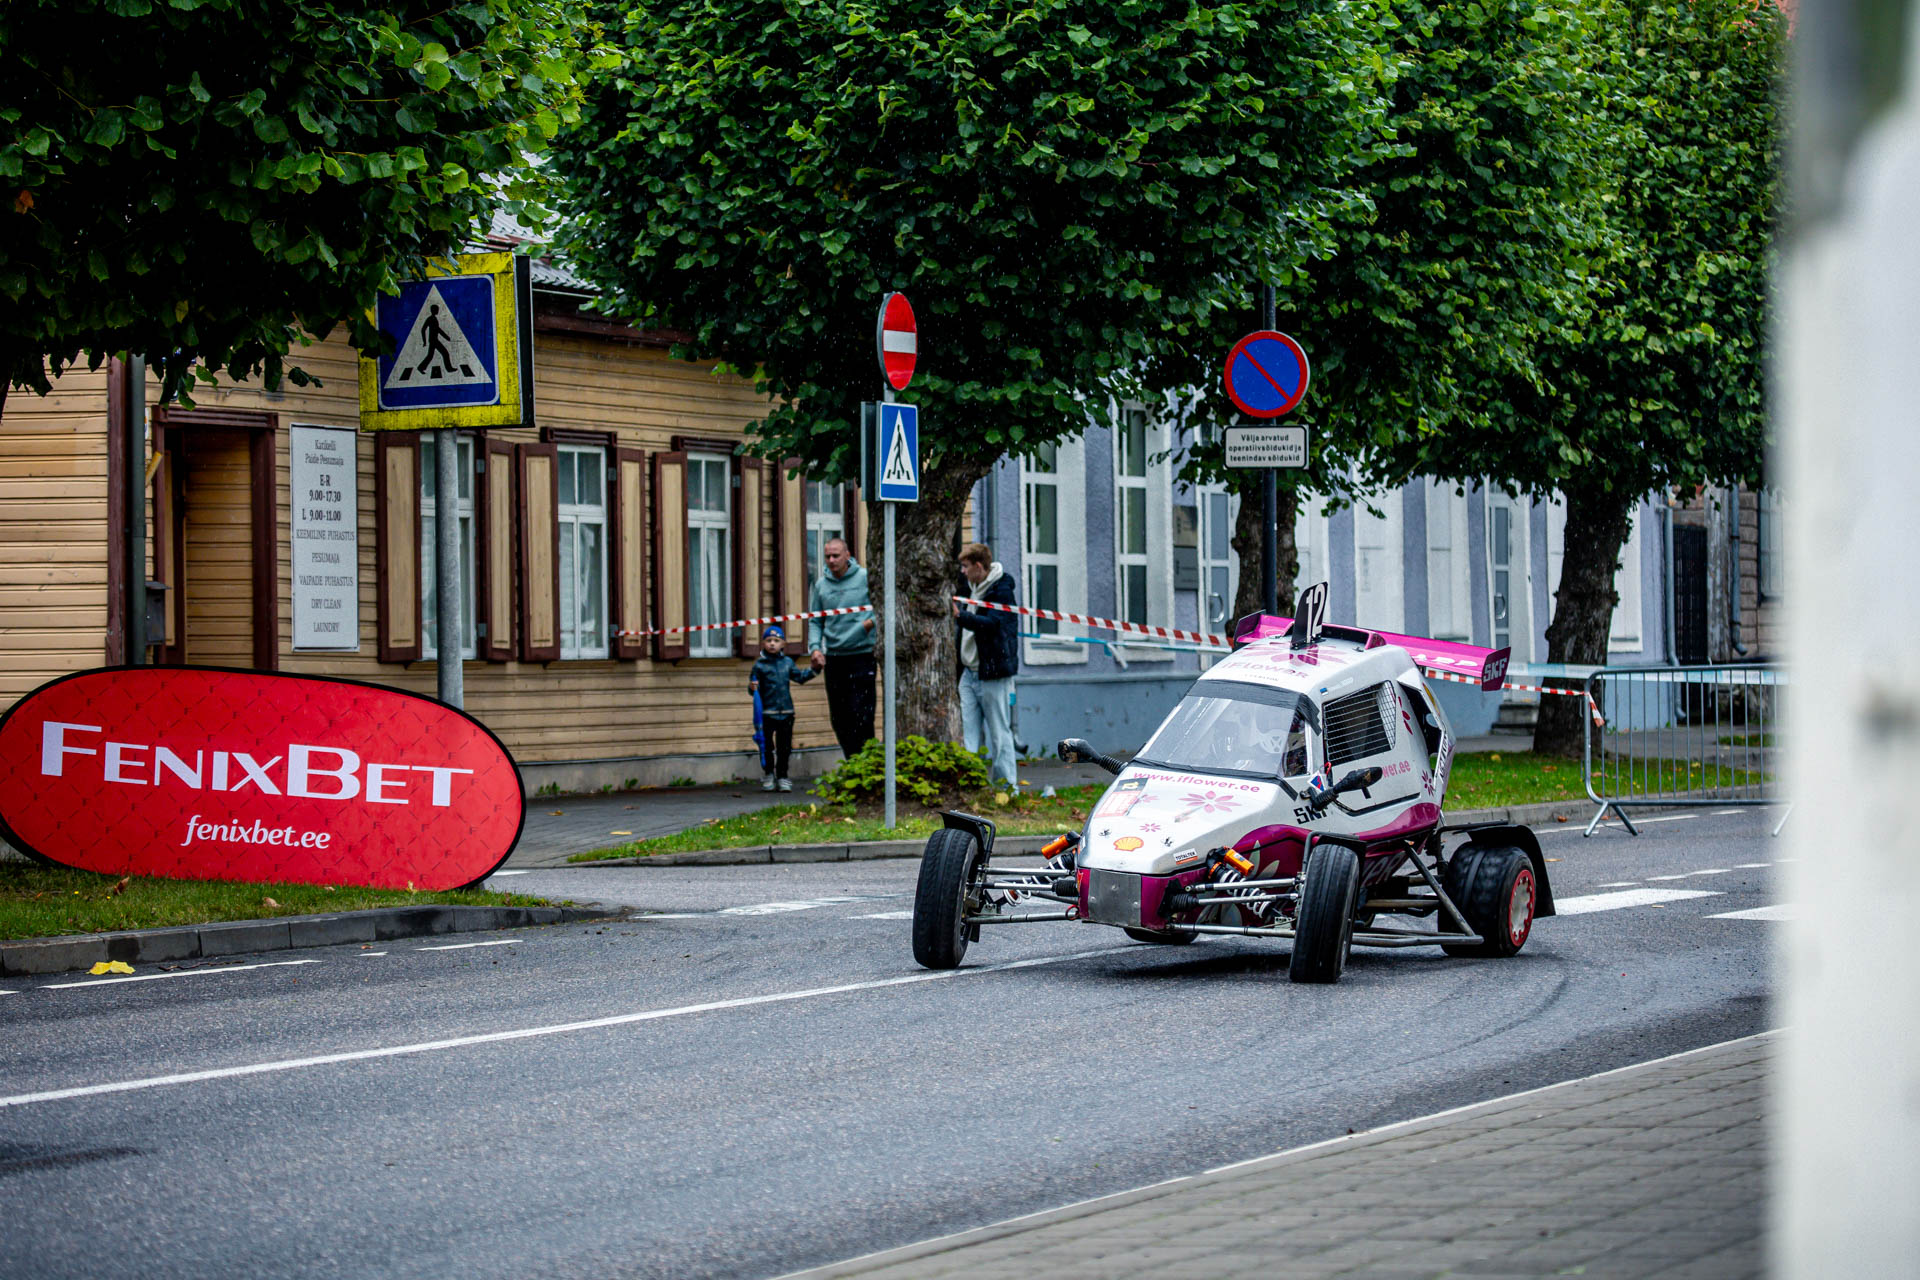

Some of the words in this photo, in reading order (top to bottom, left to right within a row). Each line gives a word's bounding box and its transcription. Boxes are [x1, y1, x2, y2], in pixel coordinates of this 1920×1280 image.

[1241, 434, 1259, 443] Välja
[320, 474, 331, 487] E-R
[309, 490, 341, 502] 9.00-17.30
[302, 508, 307, 520] L
[309, 509, 341, 521] 9.00-11.00
[296, 529, 326, 540] KEEMILINE
[327, 530, 355, 541] PUHASTUS
[312, 552, 340, 564] PESUMAJA
[299, 575, 323, 586] VAIPADE
[324, 576, 354, 587] PUHASTUS
[311, 598, 323, 609] DRY
[323, 598, 342, 610] CLEAN
[1305, 583, 1326, 644] 12
[313, 622, 339, 633] LAUNDRY
[1483, 657, 1508, 682] SKF
[1133, 771, 1261, 793] www.iflower.ee
[181, 815, 331, 849] fenixbet.ee
